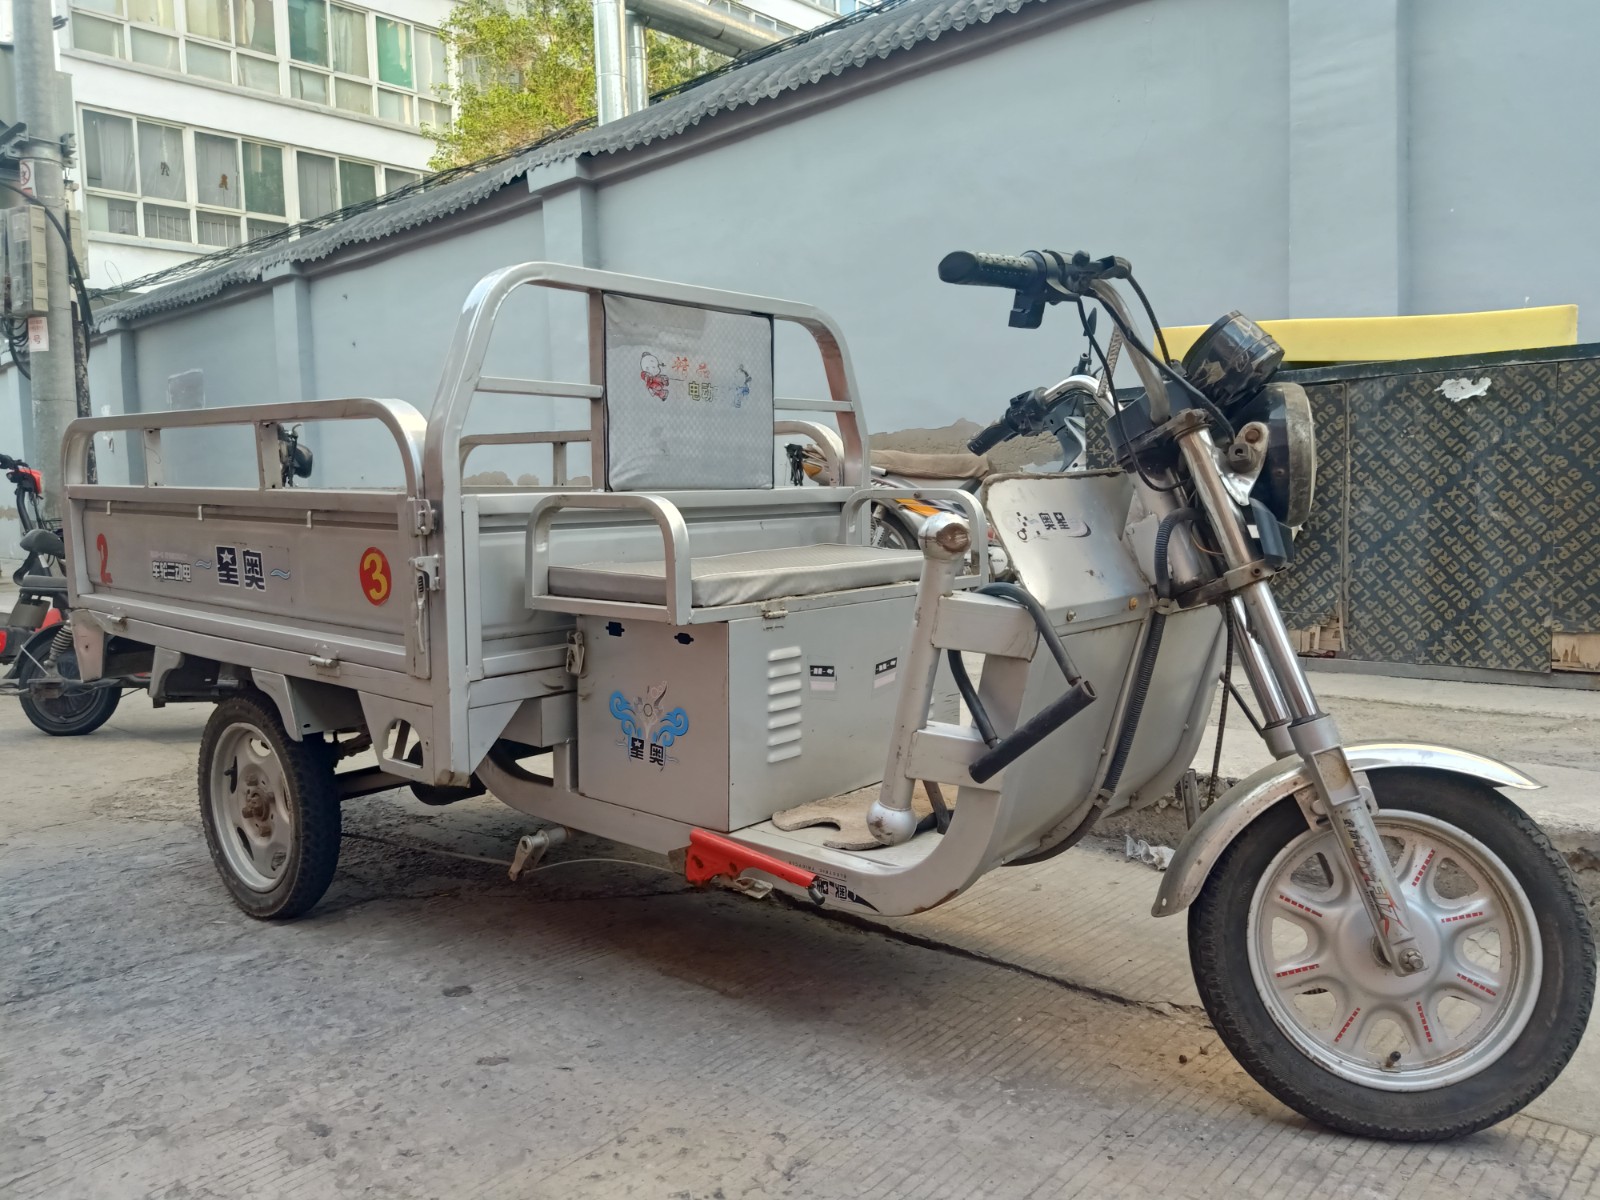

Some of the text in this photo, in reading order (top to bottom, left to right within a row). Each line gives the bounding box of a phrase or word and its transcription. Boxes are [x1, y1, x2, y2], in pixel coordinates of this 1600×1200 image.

[1370, 411, 1448, 487] SUPERPLEX
[1383, 399, 1462, 475] SUPERPLEX
[1395, 387, 1475, 464] SUPERPLEX
[1409, 374, 1489, 452] SUPERPLEX
[1357, 422, 1435, 499] SUPERPLEX
[1432, 496, 1512, 578] SUPERPLEX
[1445, 484, 1527, 567] SUPERPLEX
[1459, 473, 1541, 555] SUPERPLEX
[1473, 461, 1555, 544] SUPERPLEX
[96, 533, 113, 585] 2
[363, 552, 389, 600] 3
[1380, 541, 1458, 621] SUPERPLEX
[1392, 530, 1471, 611] SUPERPLEX
[1405, 519, 1484, 600] SUPERPLEX
[1418, 507, 1498, 589] SUPERPLEX
[1354, 562, 1430, 642] SUPERPLEX
[1367, 551, 1444, 632] SUPERPLEX
